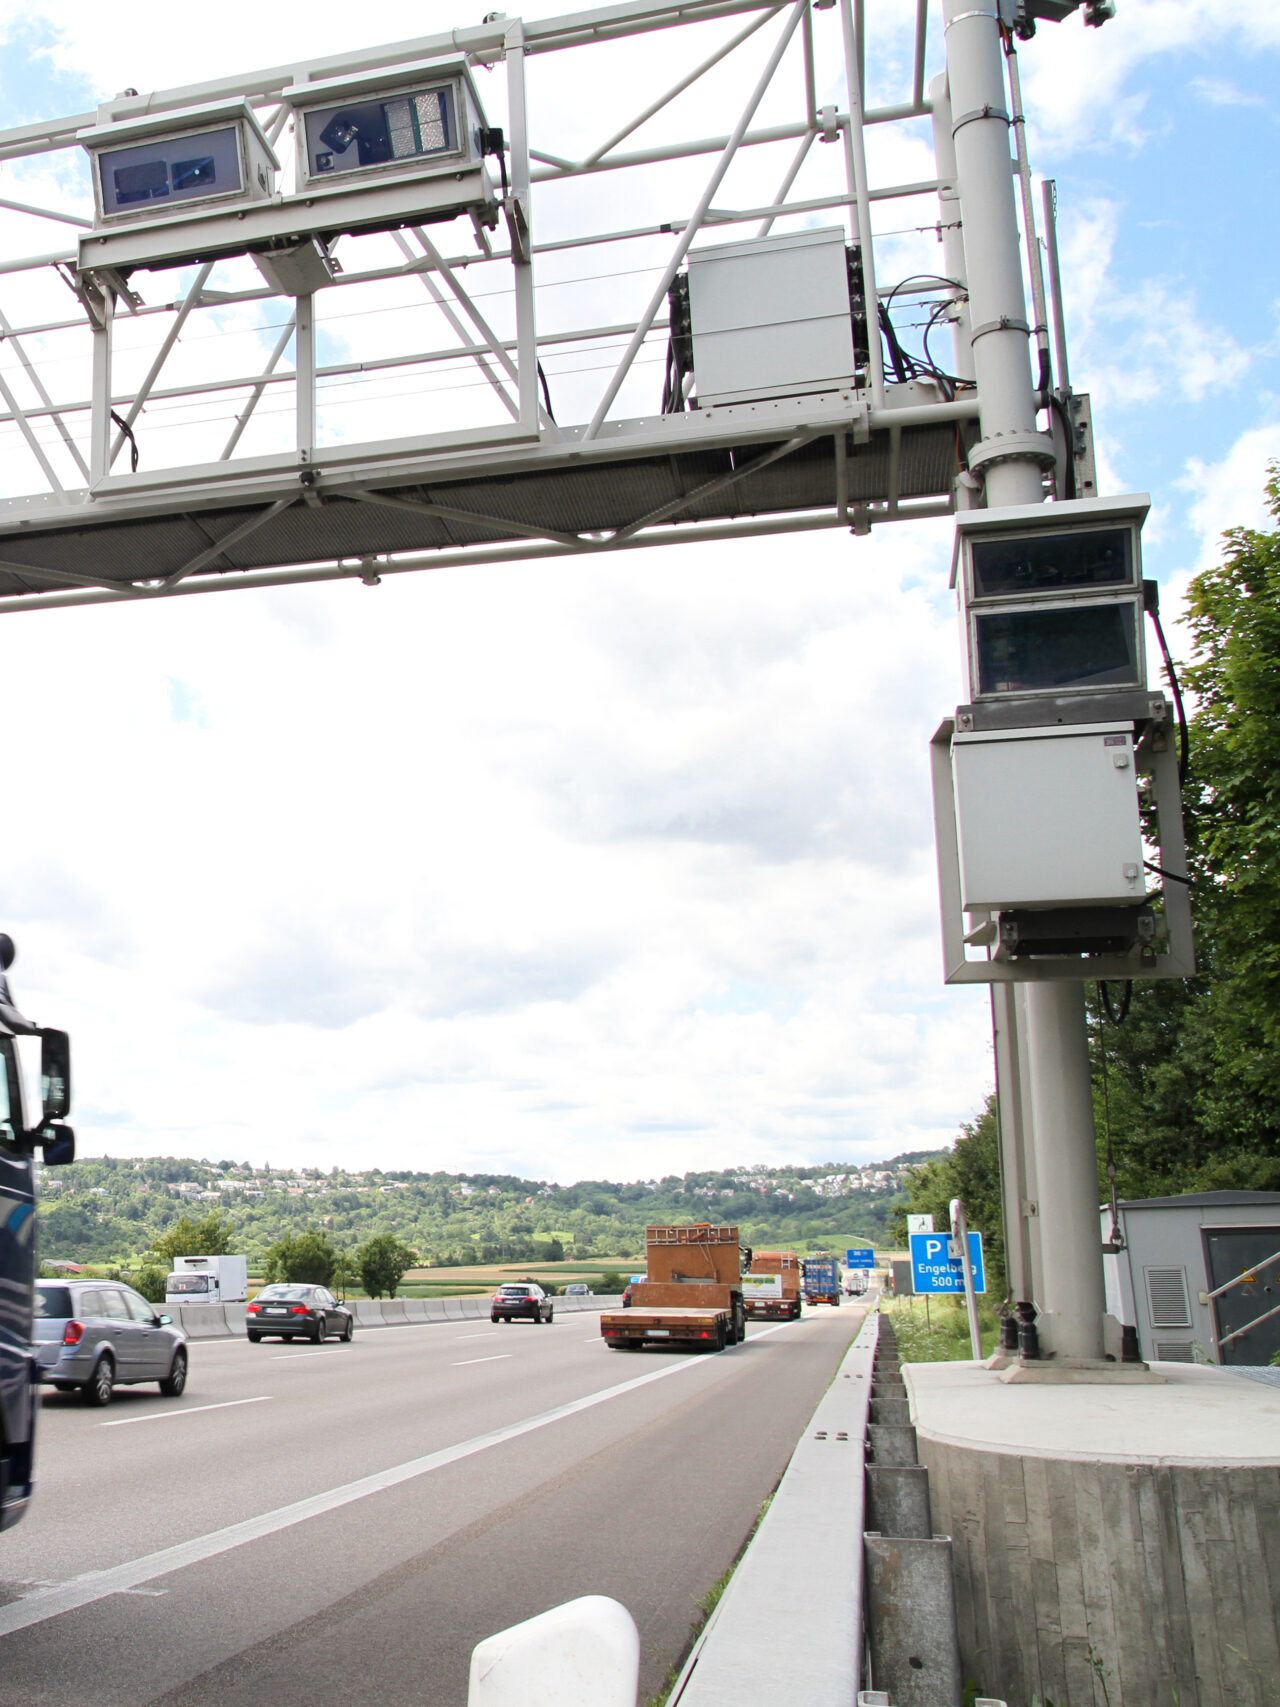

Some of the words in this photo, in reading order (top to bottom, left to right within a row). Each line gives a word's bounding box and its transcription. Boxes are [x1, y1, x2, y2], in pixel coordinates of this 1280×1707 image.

[926, 1240, 942, 1260] P
[918, 1263, 977, 1276] Engelbeg
[931, 1276, 952, 1287] 500
[954, 1278, 965, 1287] m
